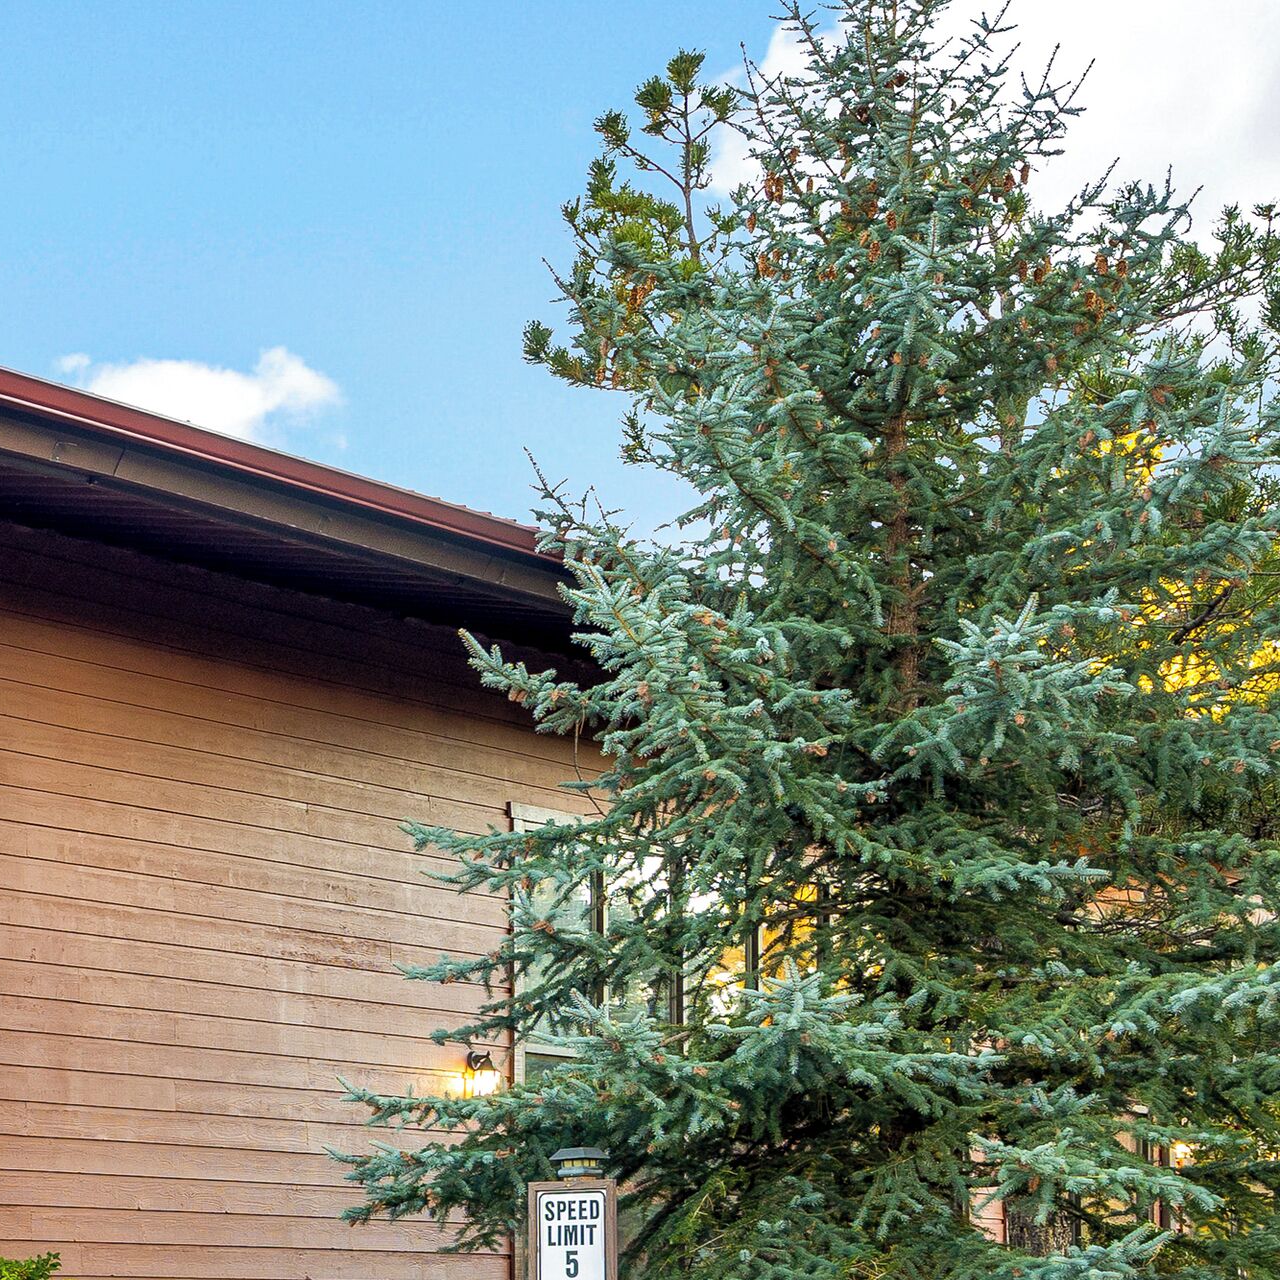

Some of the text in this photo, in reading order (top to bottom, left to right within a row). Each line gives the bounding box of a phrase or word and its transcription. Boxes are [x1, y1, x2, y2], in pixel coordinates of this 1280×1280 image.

[544, 1200, 600, 1221] SPEED
[547, 1224, 597, 1246] LIMIT
[565, 1250, 580, 1278] 5
